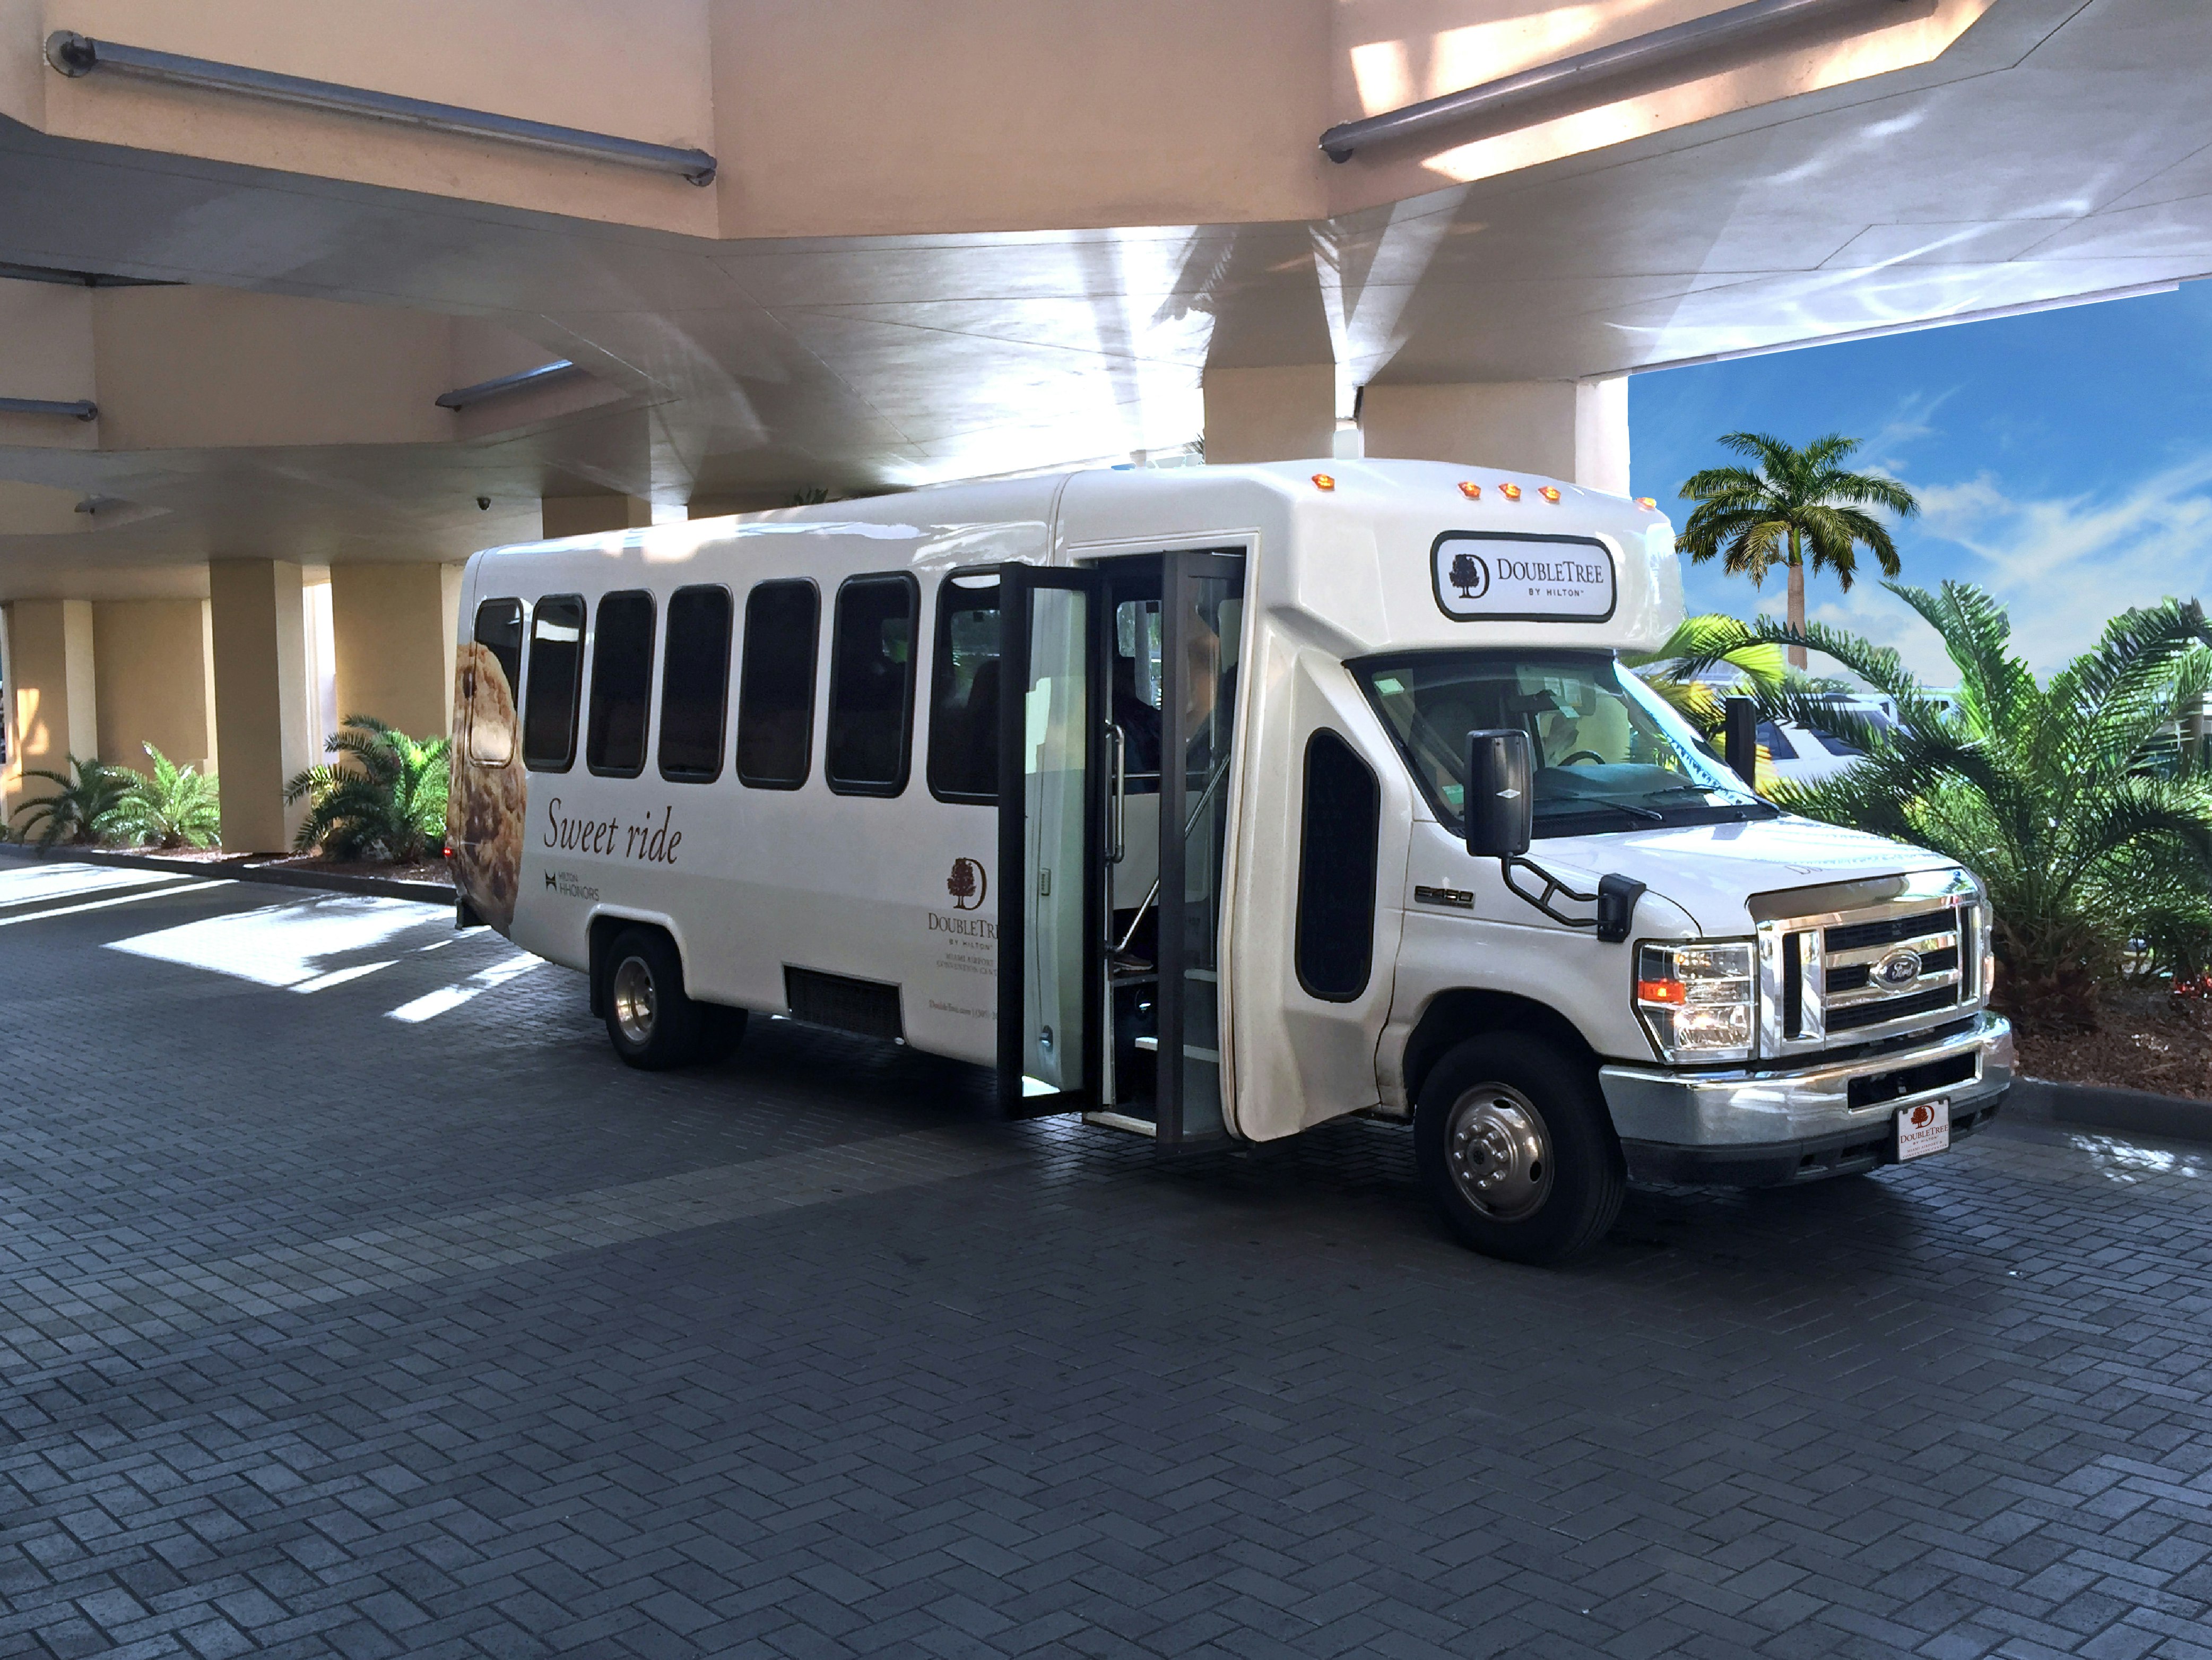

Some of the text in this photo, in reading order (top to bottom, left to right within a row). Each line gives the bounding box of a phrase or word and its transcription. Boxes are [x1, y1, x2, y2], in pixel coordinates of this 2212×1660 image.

[1496, 558, 1604, 583] DOUBLETREE
[544, 798, 682, 864] Sweet ride
[560, 883, 600, 901] HHONORS
[929, 912, 998, 938] DOUBLETR
[1900, 1125, 1948, 1143] DOUBLETREE
[1903, 1148, 1930, 1158] CONVENTION
[1921, 1141, 1938, 1149] AIRPORT
